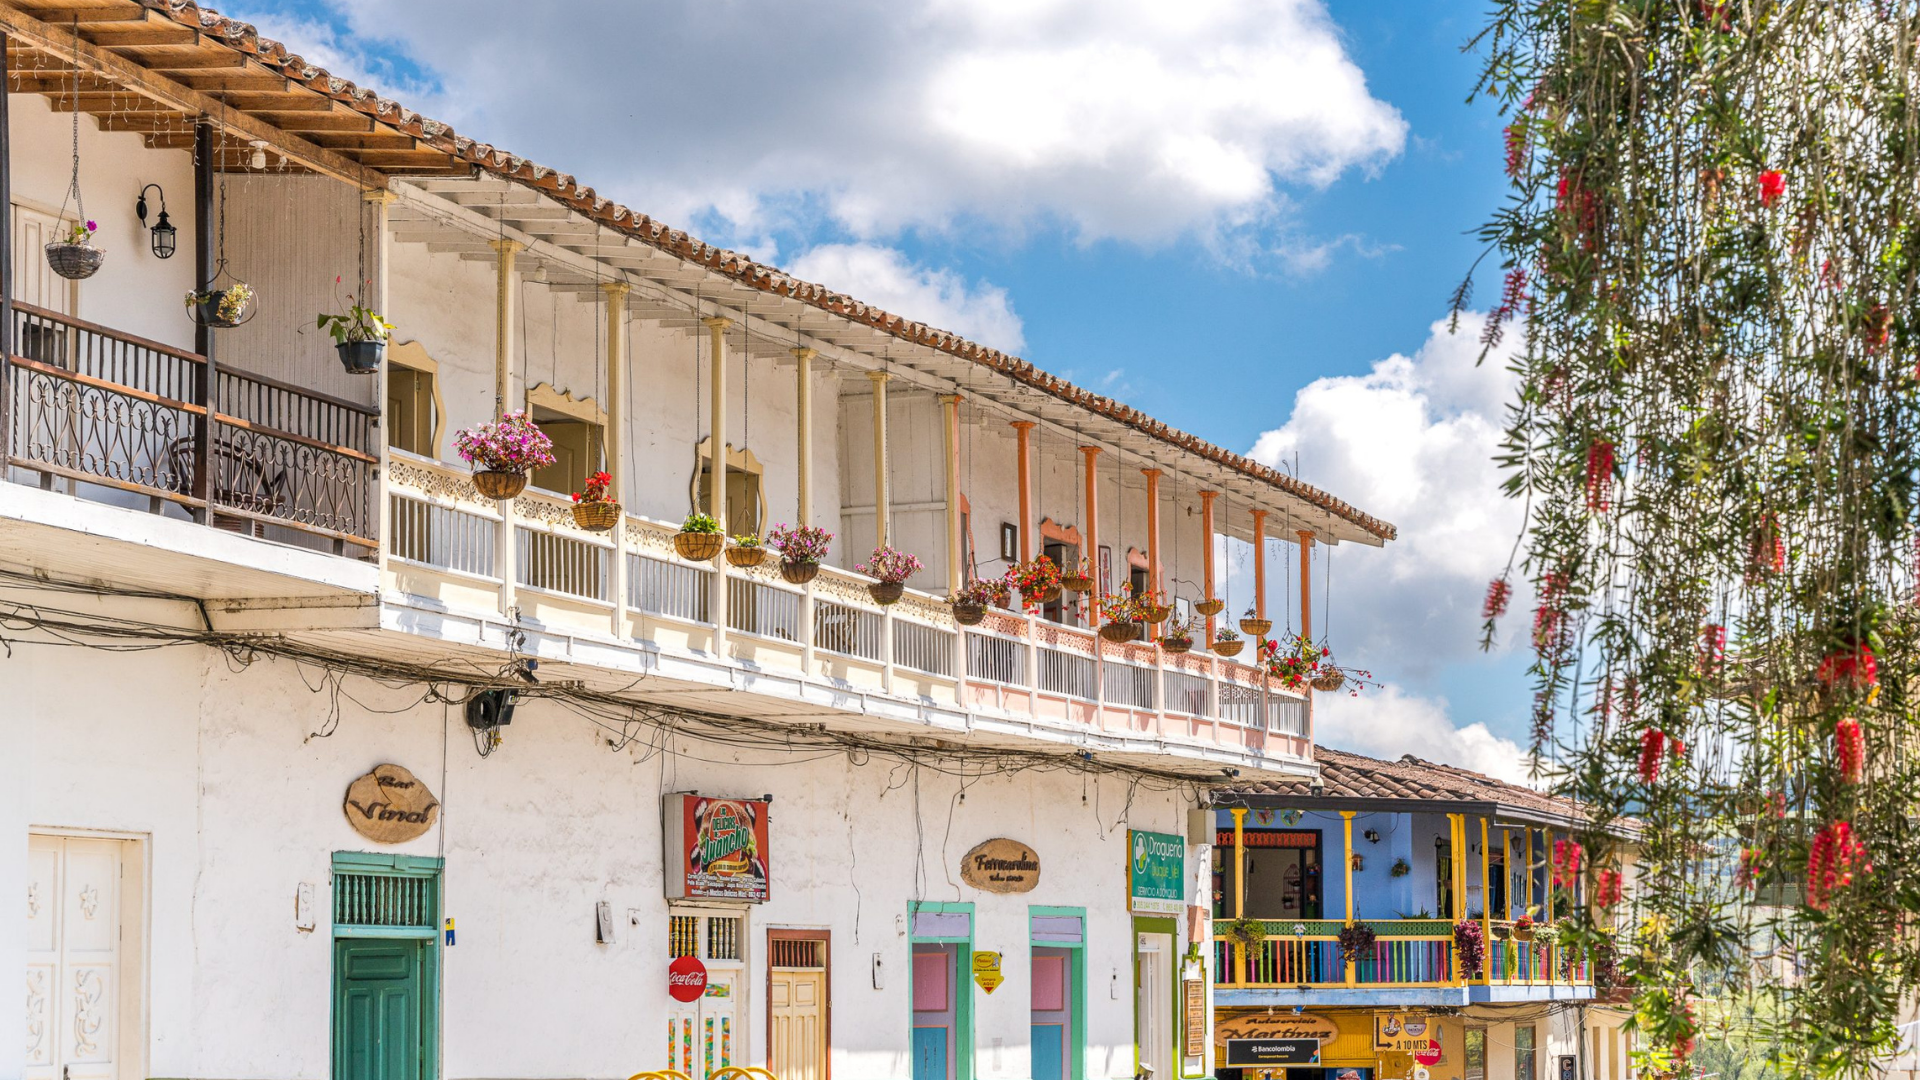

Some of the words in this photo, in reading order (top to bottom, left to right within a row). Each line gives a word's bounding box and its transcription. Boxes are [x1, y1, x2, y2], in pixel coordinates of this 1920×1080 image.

[378, 775, 415, 789] Bar
[712, 816, 736, 830] DELICIAS
[701, 824, 749, 865] Juancho
[1149, 836, 1182, 861] Droguería
[1137, 886, 1155, 897] SERVICIO
[1258, 1044, 1295, 1052] Bancolombia
[1396, 1040, 1401, 1049] A
[1404, 1040, 1411, 1050] 10
[1413, 1040, 1428, 1050] MTS
